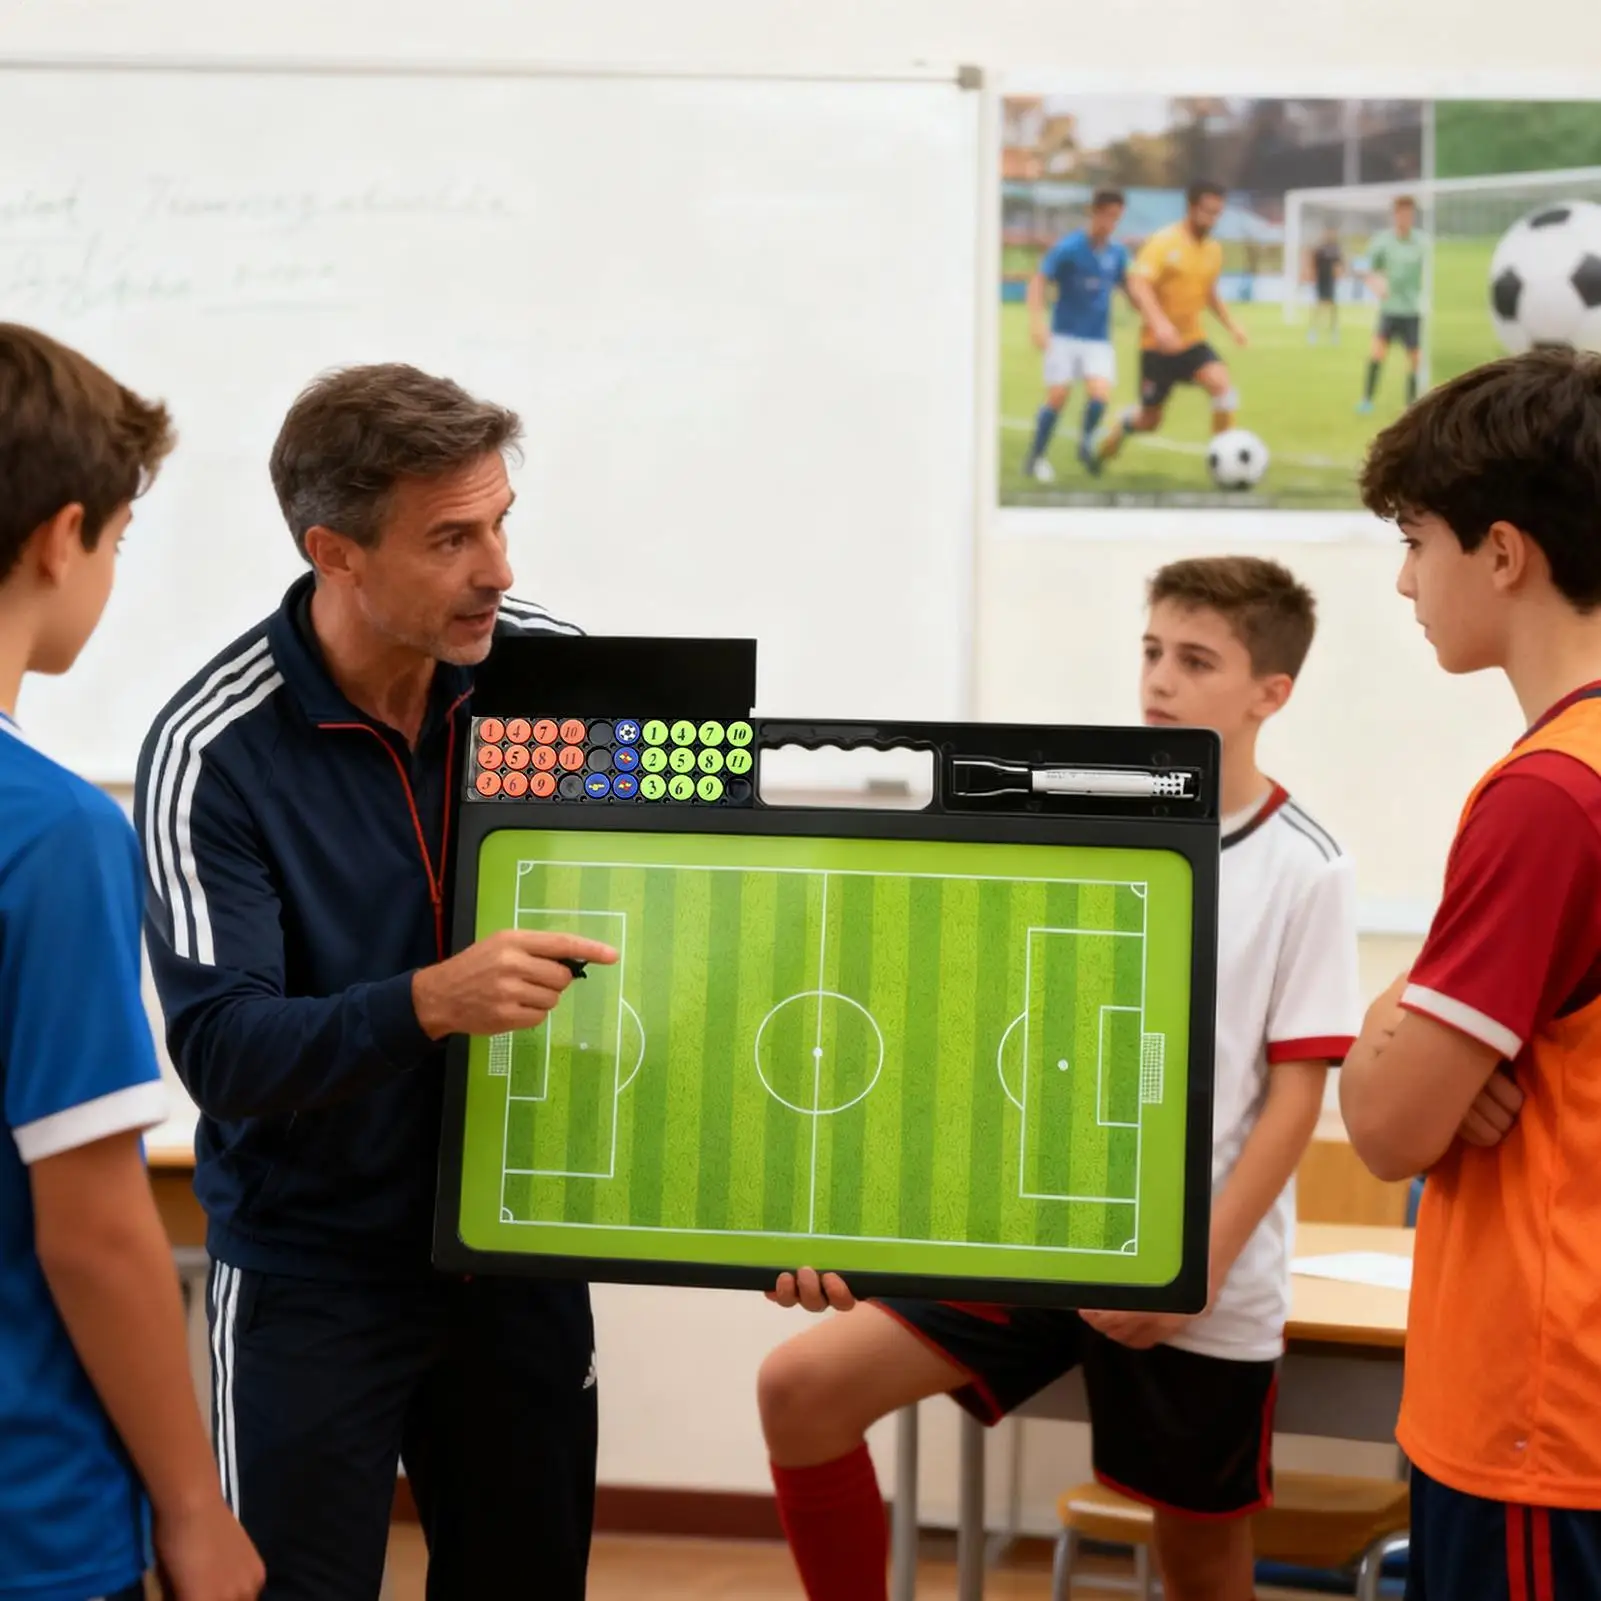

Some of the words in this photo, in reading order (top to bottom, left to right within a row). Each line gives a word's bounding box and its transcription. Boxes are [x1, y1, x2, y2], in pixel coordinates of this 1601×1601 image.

[512, 725, 520, 738] 4
[540, 726, 548, 740] 7
[564, 726, 578, 738] 10
[677, 727, 686, 741] 4
[706, 727, 714, 740] 7
[733, 728, 747, 741] 10
[484, 750, 493, 764] 2
[512, 750, 520, 763] 5
[538, 751, 546, 766] 8
[563, 753, 576, 766] 11
[649, 753, 657, 767] 2
[677, 753, 685, 768] 5
[705, 755, 714, 768] 8
[731, 755, 745, 768] 11
[482, 777, 492, 789] 3
[509, 778, 517, 792] 6
[537, 779, 546, 791] 9
[649, 780, 657, 794] 3
[675, 782, 683, 795] 6
[705, 782, 714, 795] 9
